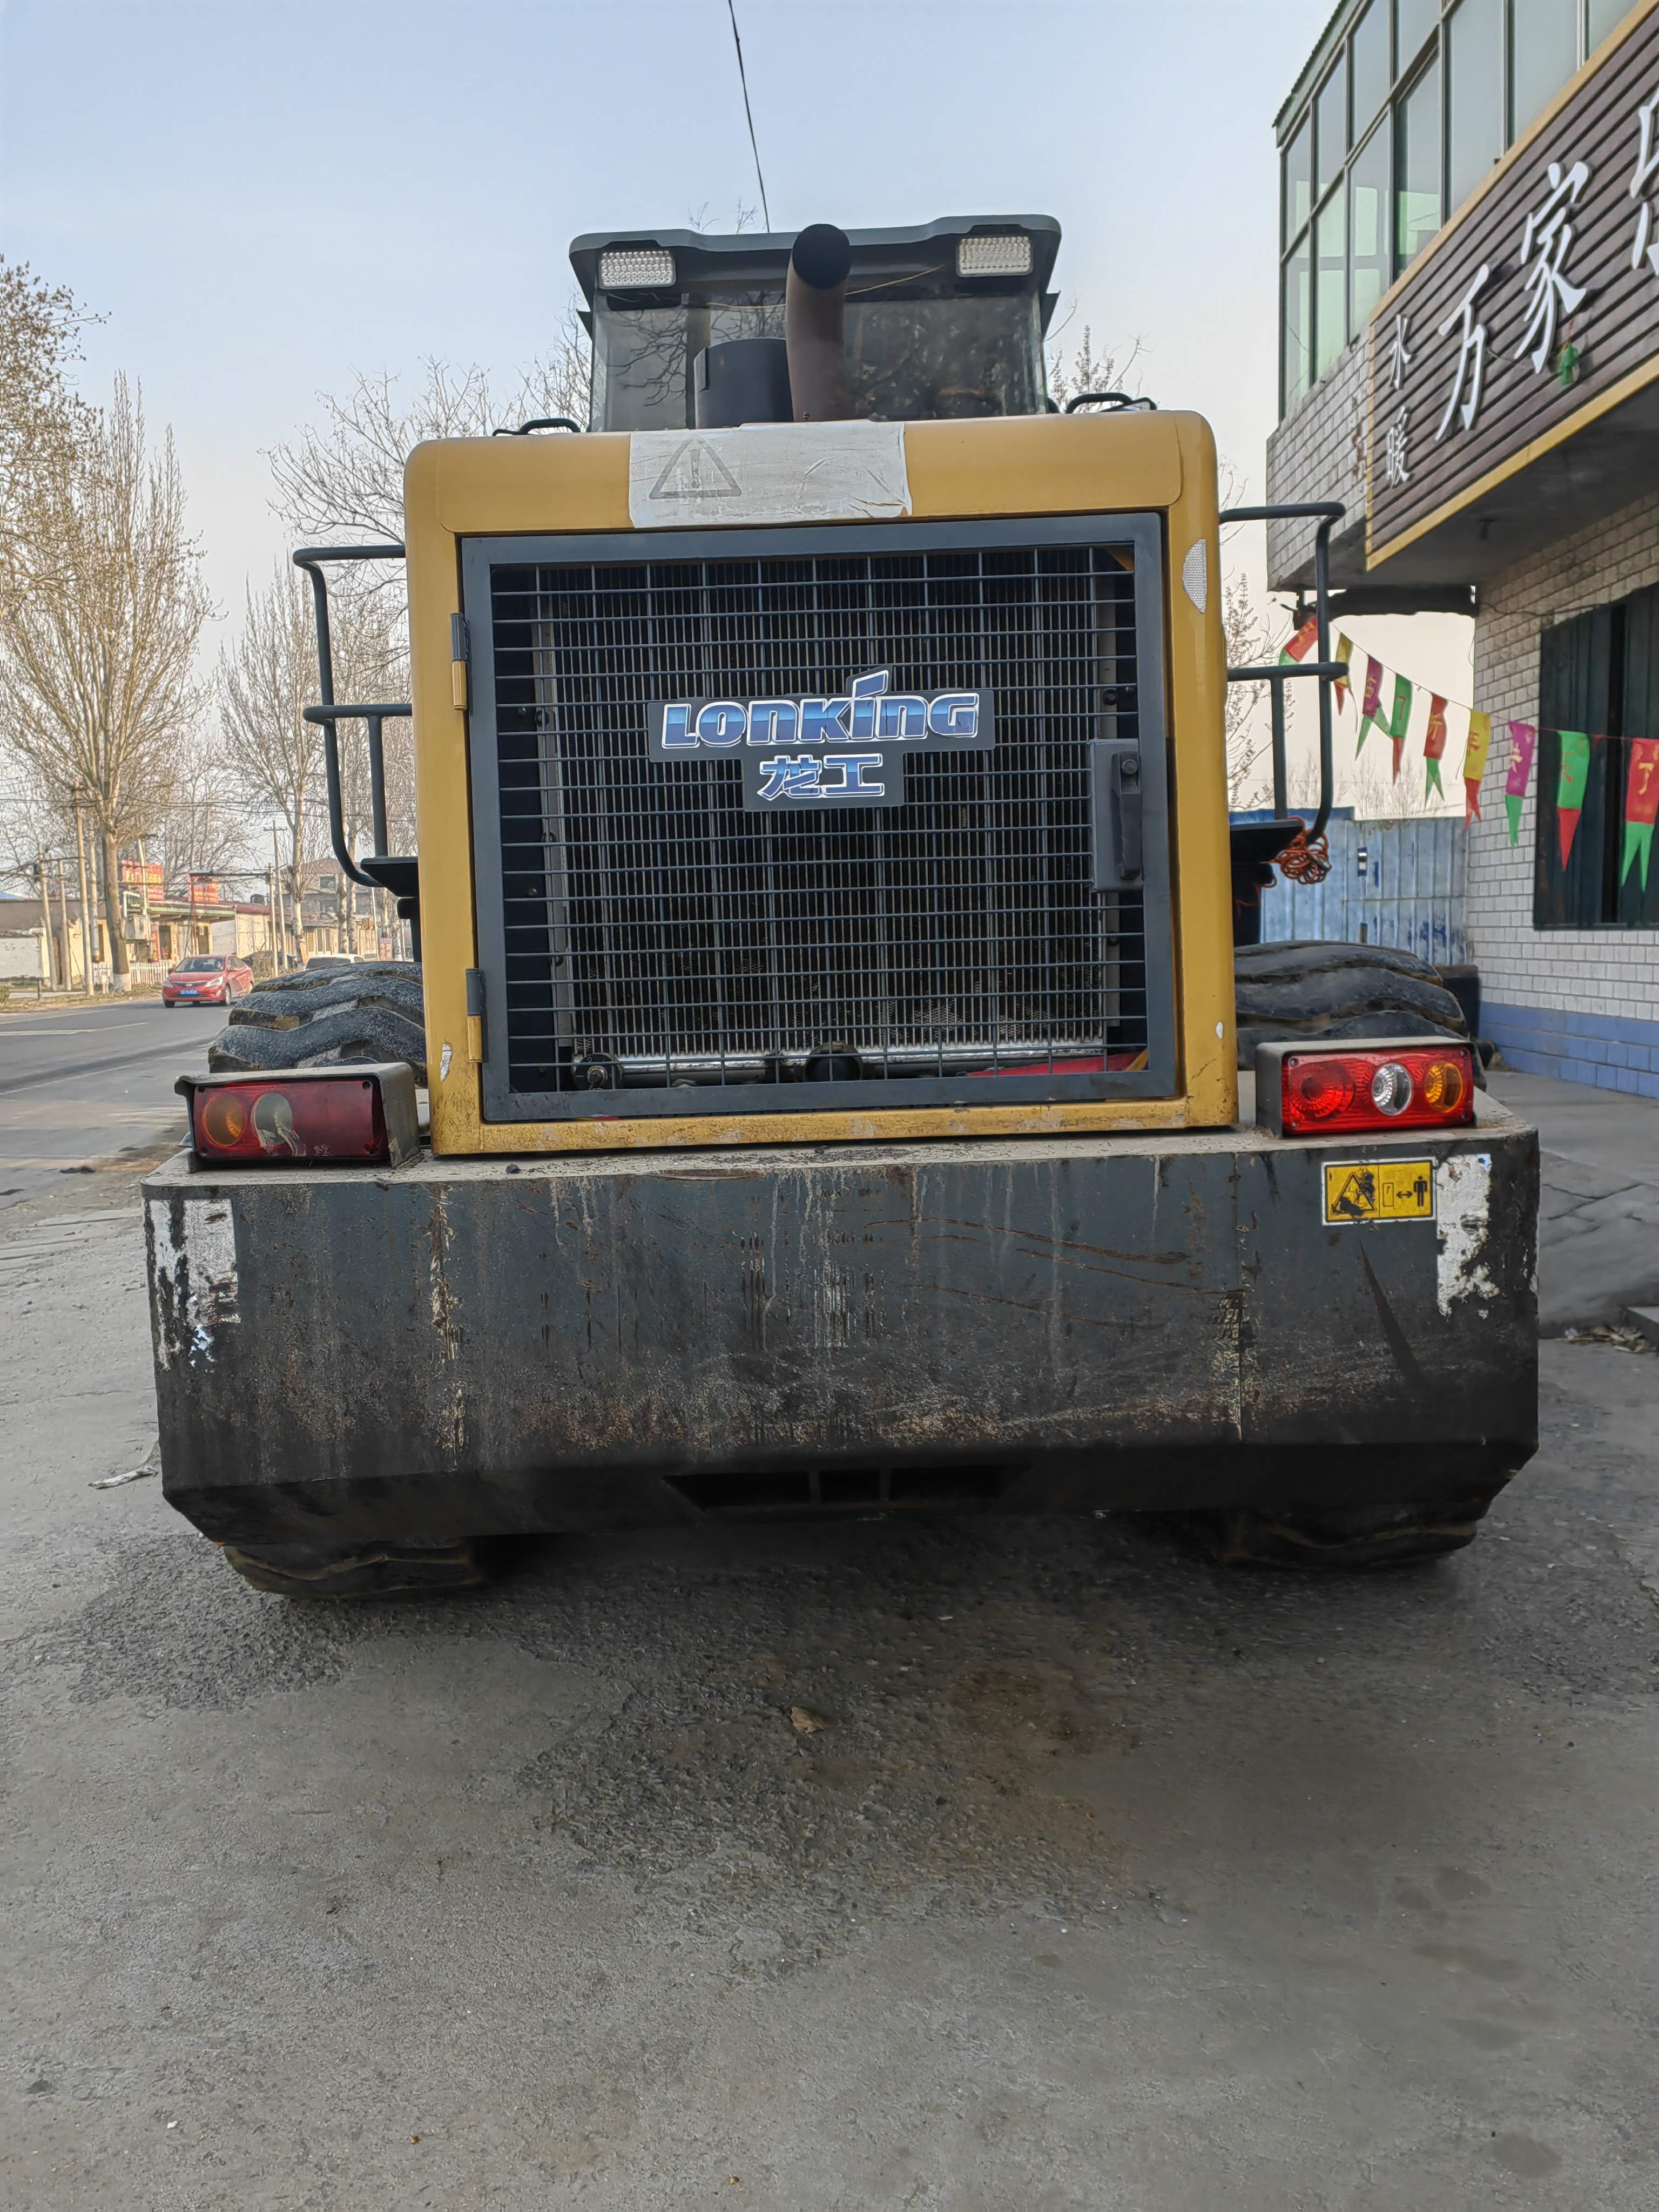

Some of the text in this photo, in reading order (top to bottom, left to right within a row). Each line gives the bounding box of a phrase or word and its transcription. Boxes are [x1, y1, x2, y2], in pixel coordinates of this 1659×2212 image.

[1386, 313, 1412, 489] 水暖
[662, 670, 979, 748] LONKING
[757, 753, 885, 800] 龙工
